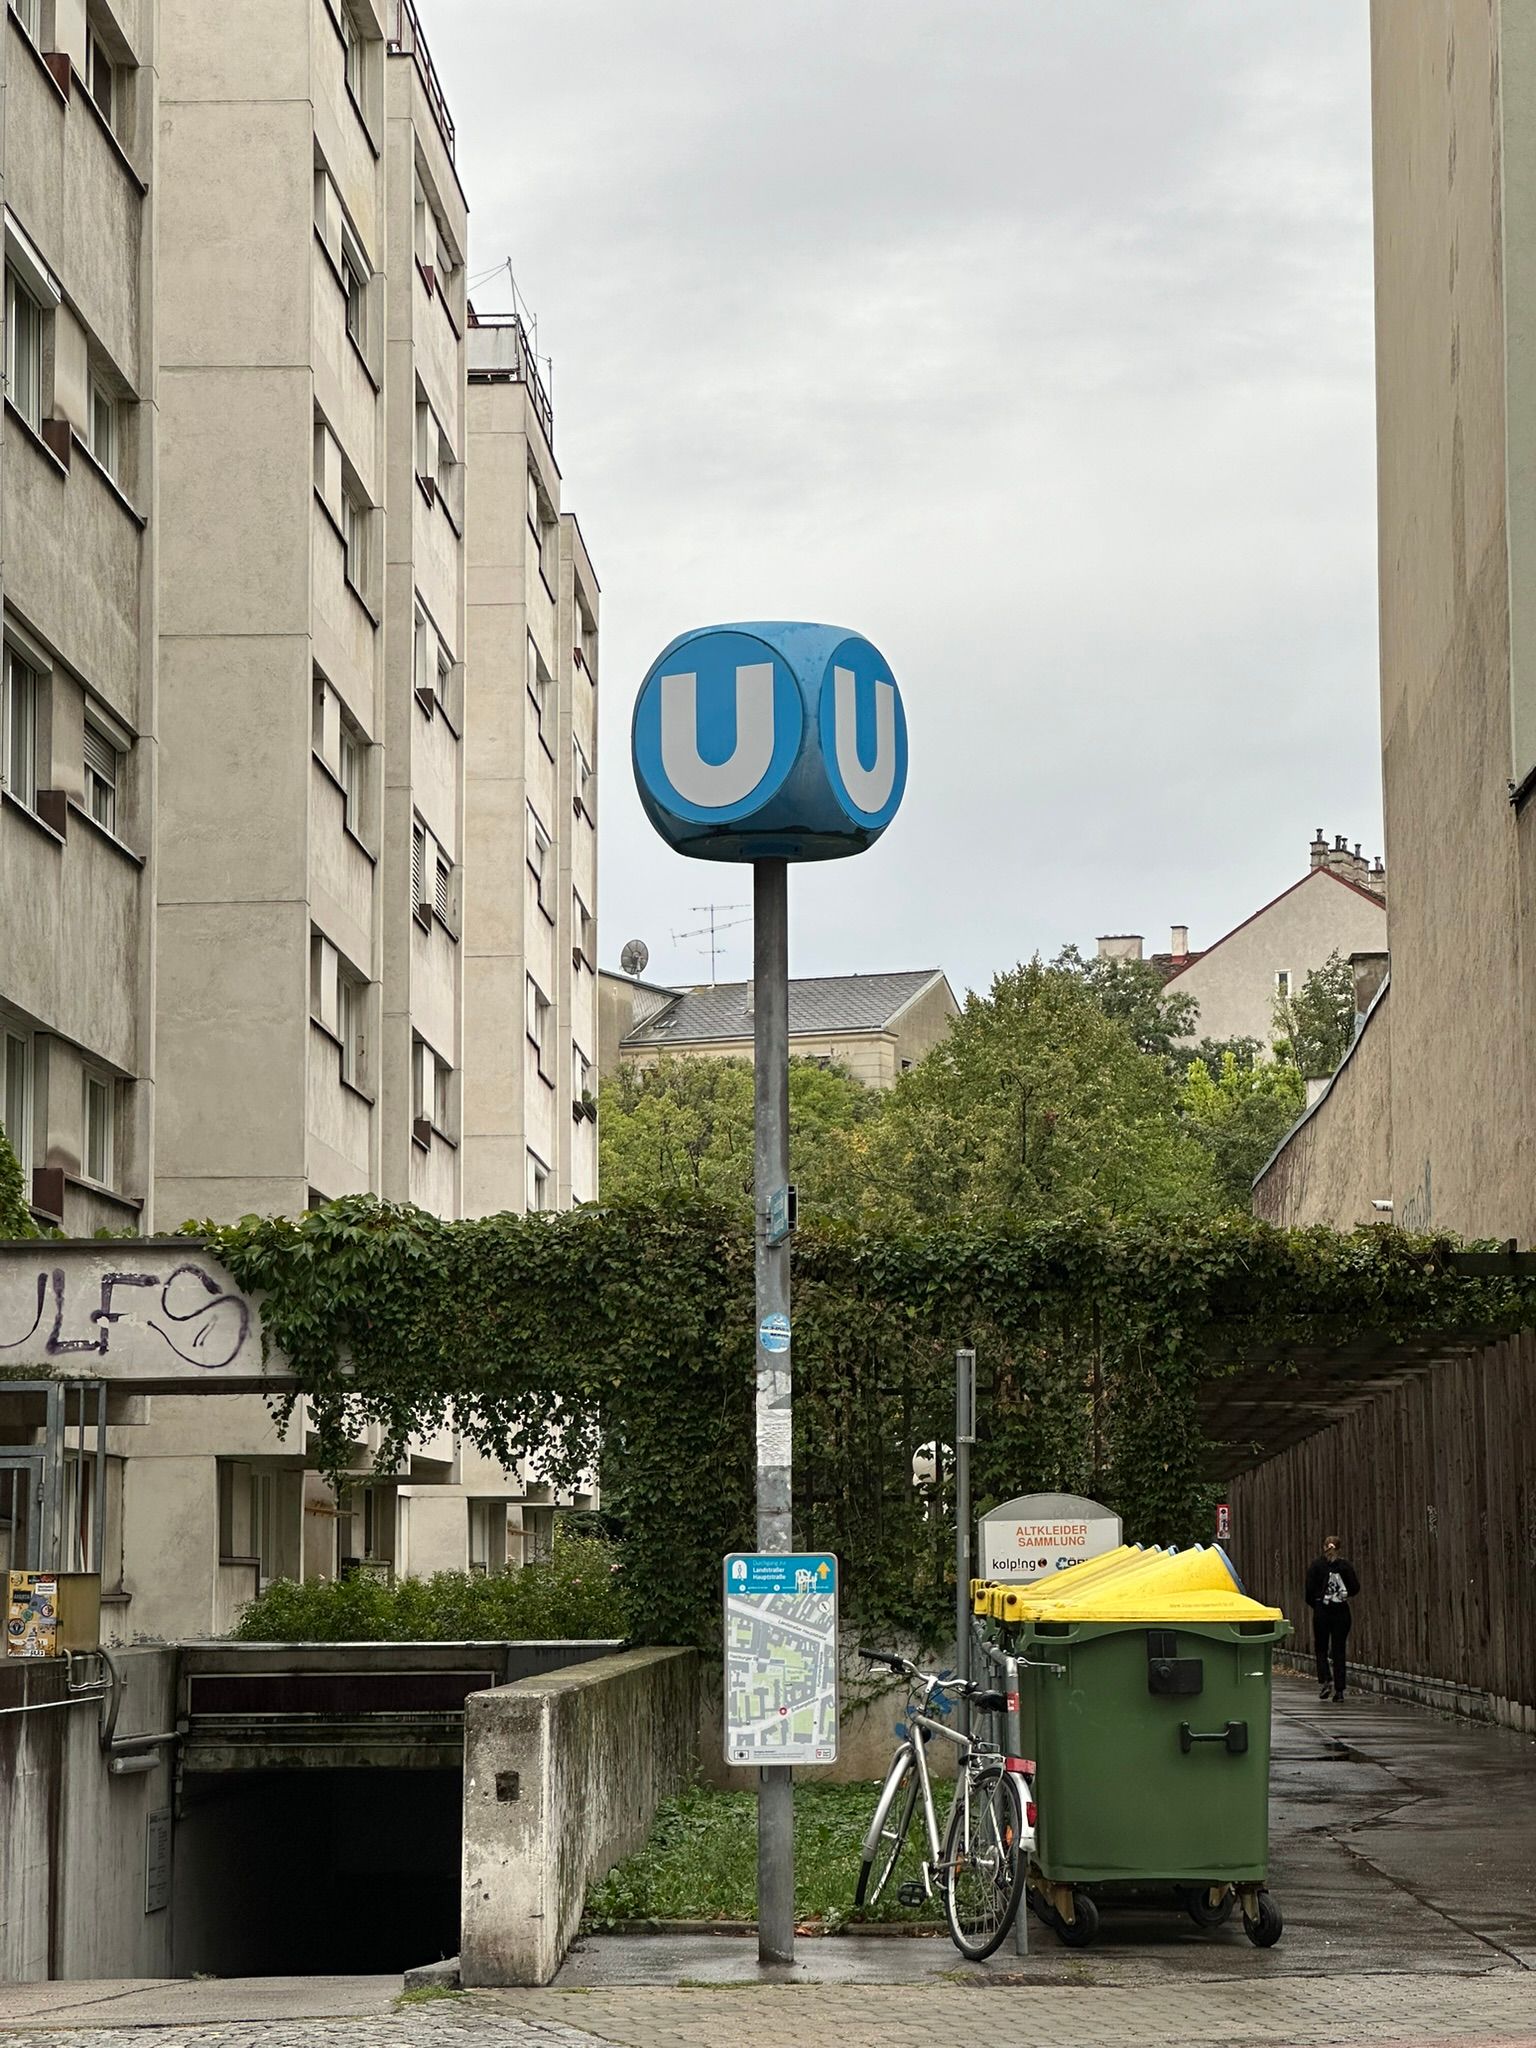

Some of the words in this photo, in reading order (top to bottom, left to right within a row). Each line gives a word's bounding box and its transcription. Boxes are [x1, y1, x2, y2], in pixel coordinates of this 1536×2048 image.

[660, 662, 775, 808] U
[833, 665, 896, 814] U
[1016, 1525, 1087, 1536] ALTKLEIDER
[1018, 1536, 1085, 1547] SAMMLUNG
